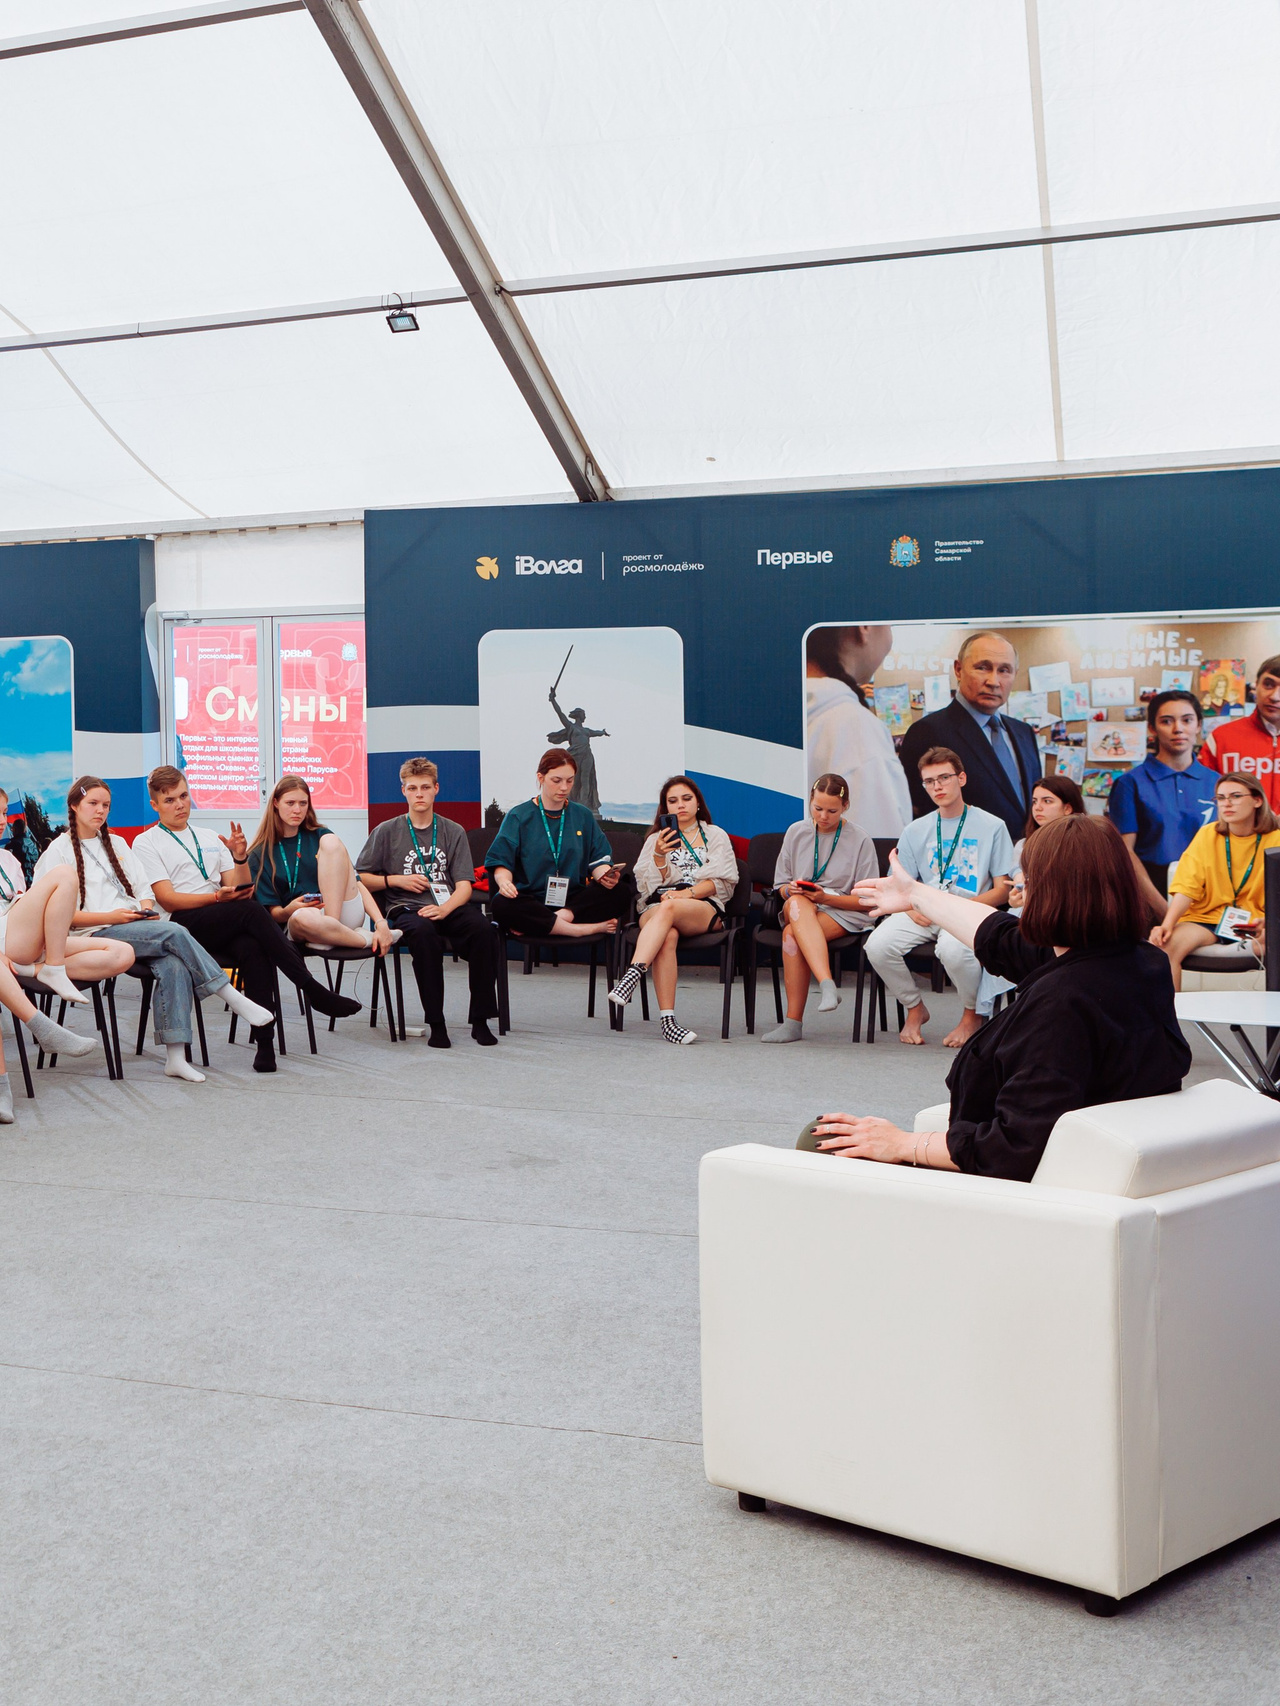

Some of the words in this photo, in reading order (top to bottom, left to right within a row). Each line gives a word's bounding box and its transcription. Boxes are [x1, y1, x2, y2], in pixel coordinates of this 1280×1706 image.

[622, 554, 651, 563] проект
[653, 553, 663, 561] от
[757, 549, 833, 570] Первые
[515, 555, 583, 575] iВолга
[622, 561, 705, 577] росмолодёжь
[280, 649, 312, 661] ервые
[882, 655, 955, 673] ВМЕСТ
[180, 733, 207, 743] Первых
[227, 736, 259, 744] интерес
[282, 755, 322, 763] оссийских
[218, 774, 245, 782] центре
[228, 783, 258, 791] лагерей
[403, 850, 418, 875] BASS
